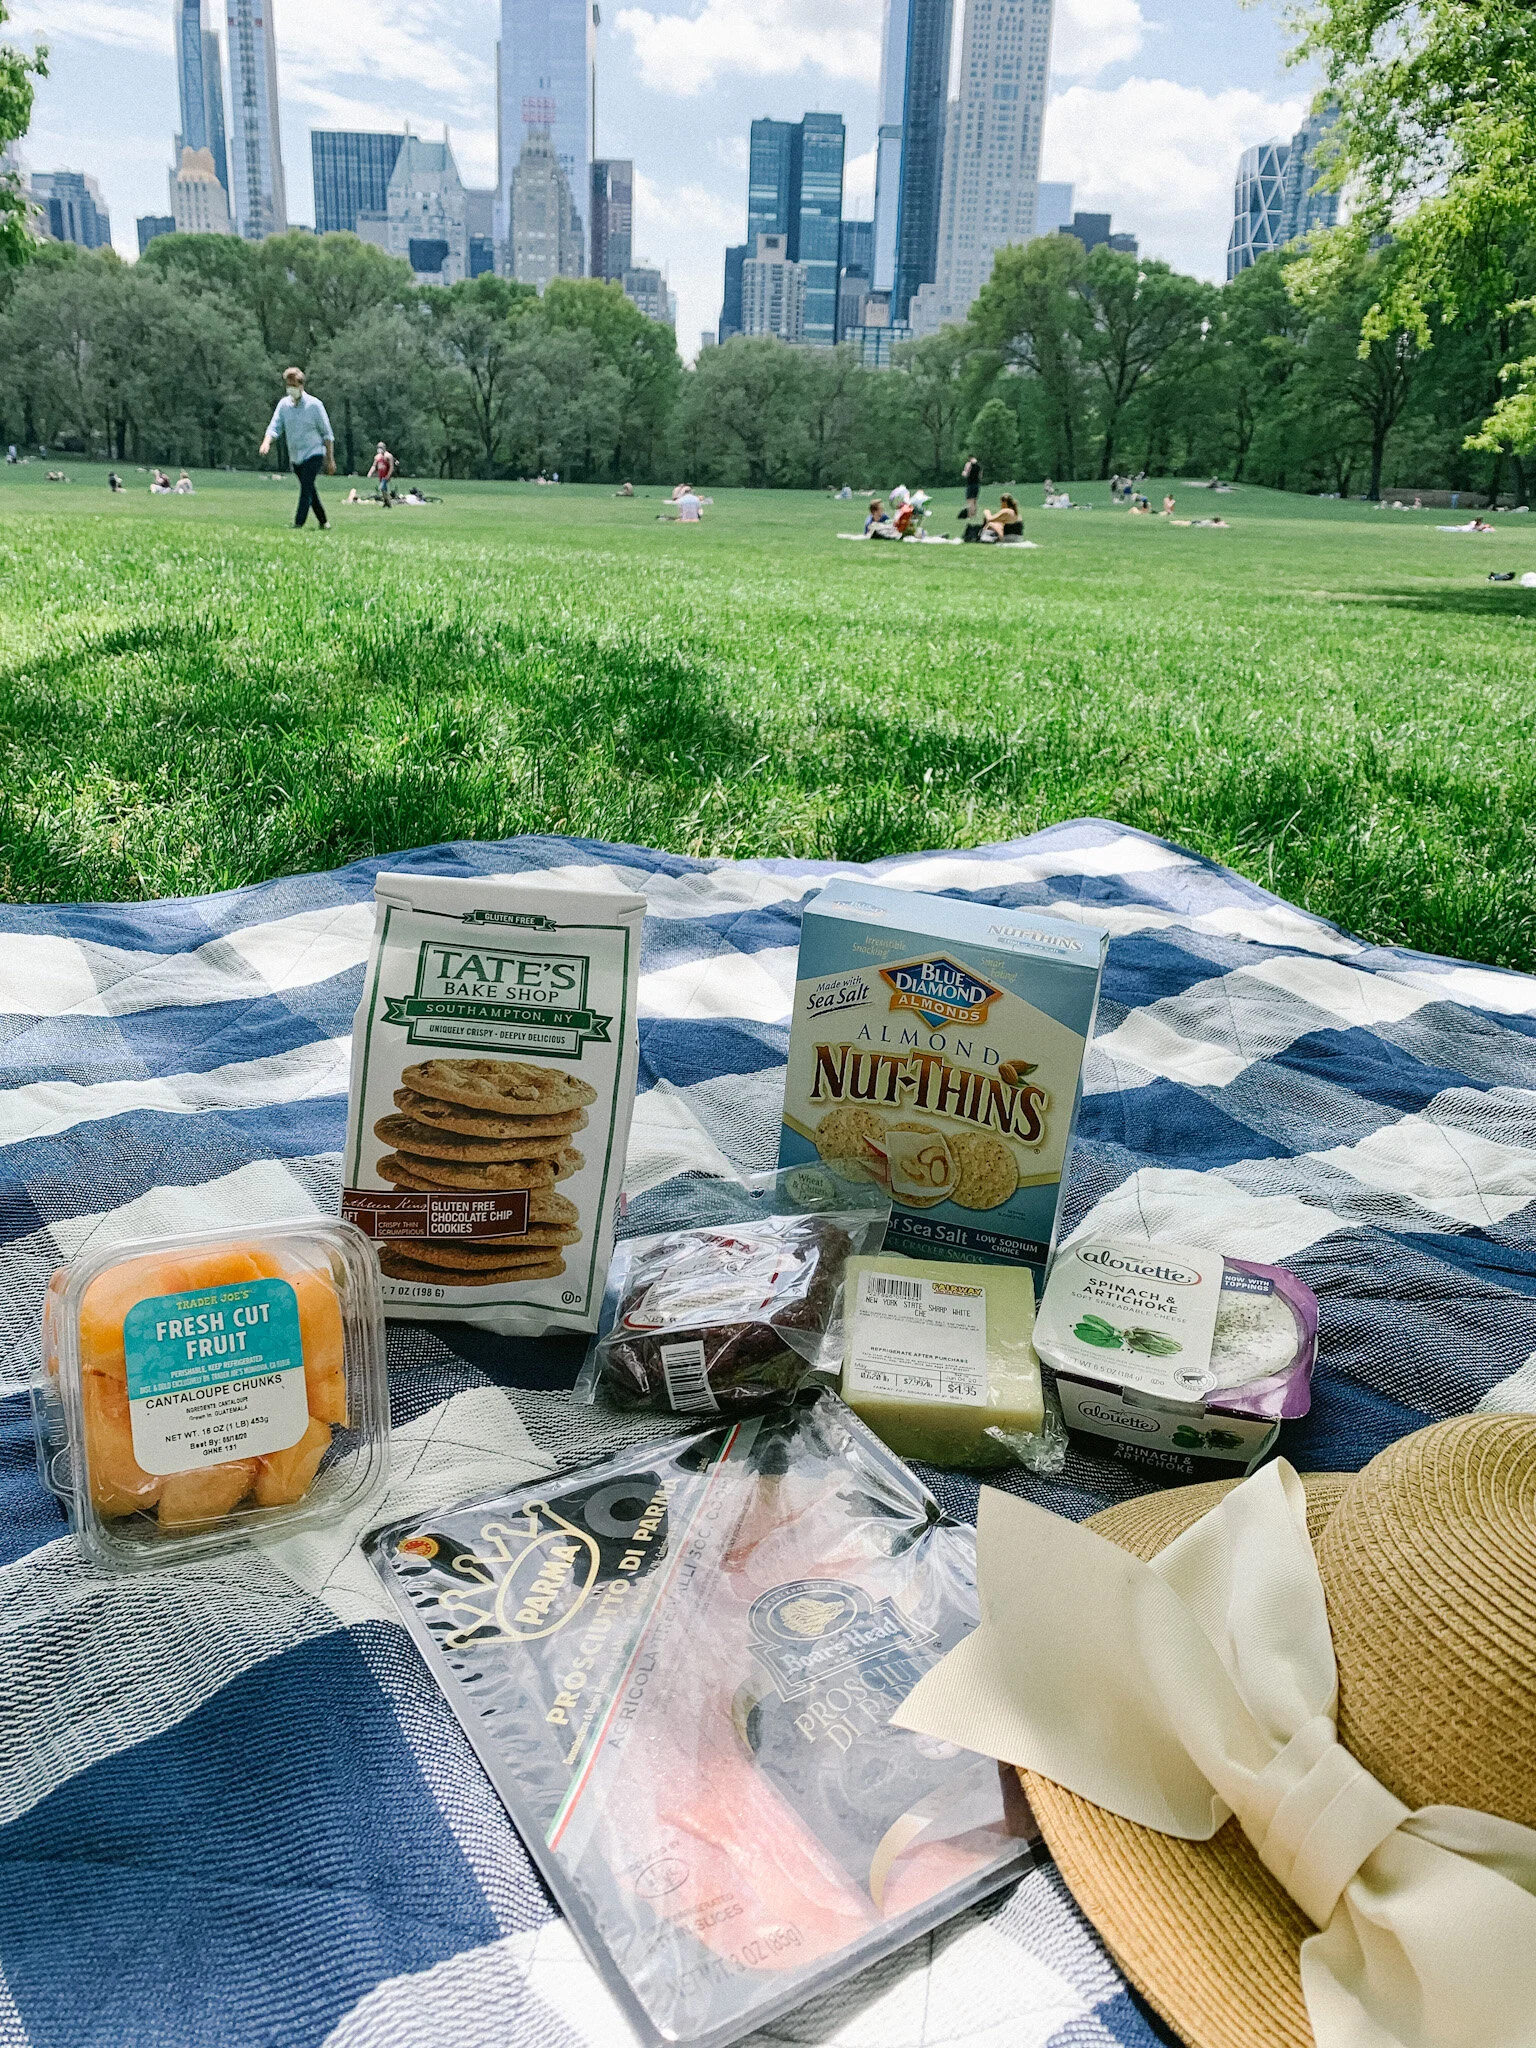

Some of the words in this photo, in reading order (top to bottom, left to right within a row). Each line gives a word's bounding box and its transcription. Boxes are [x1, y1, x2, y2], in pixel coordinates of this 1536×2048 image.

[483, 912, 514, 924] GLUTEN
[515, 915, 536, 925] FREE
[433, 949, 576, 990] TATE'S
[920, 962, 965, 987] BLUE
[444, 981, 498, 998] BAKE
[506, 986, 560, 1003] SHOP
[816, 978, 840, 993] Made
[840, 975, 862, 989] with
[895, 971, 987, 1004] DIAMOND
[806, 992, 834, 1011] Sea
[837, 984, 870, 1004] Salt
[898, 994, 981, 1022] ALMONDS
[425, 1003, 546, 1023] SOUTHAMPTON,
[553, 1013, 574, 1025] NY
[429, 1024, 465, 1036] UNIQUELY
[466, 1027, 494, 1038] CRISPY
[499, 1030, 527, 1041] DEEPLY
[527, 1033, 566, 1045] DELICIOUS
[856, 1023, 1001, 1066] ALMOND
[342, 1211, 359, 1222] AFT
[431, 1200, 472, 1212] GLUTEN
[473, 1200, 496, 1212] FREE
[431, 1211, 487, 1223] CHOCOLATE
[489, 1210, 513, 1221] CHIP
[431, 1222, 473, 1235] COOKIES
[902, 1218, 932, 1237] Sea
[934, 1226, 968, 1245] Salt
[975, 1233, 997, 1243] LOW
[999, 1238, 1038, 1253] SODIUM
[991, 1244, 1020, 1256] CHOICE
[1083, 1250, 1186, 1283] alouette
[390, 1286, 395, 1295] 7
[398, 1287, 410, 1296] OZ
[412, 1287, 432, 1297] (198
[931, 1282, 982, 1296] FAIRWAY
[1088, 1278, 1163, 1303] SPINACH
[1166, 1296, 1176, 1305] &
[1224, 1280, 1270, 1292] TOPPINGS
[1225, 1274, 1246, 1284] NOW
[1247, 1277, 1270, 1287] WITH
[176, 1295, 218, 1311] TRADER
[220, 1290, 250, 1303] JOE'S
[865, 1296, 878, 1304] NEW
[882, 1298, 898, 1306] YORK
[903, 1301, 922, 1310] STATE
[952, 1308, 971, 1317] WHITE
[1071, 1291, 1093, 1302] SOFT
[1095, 1296, 1152, 1317] SPREADABLE
[1153, 1311, 1187, 1324] CHEESE
[1082, 1285, 1179, 1315] ARTICHOKE
[155, 1311, 225, 1342] FRESH
[232, 1303, 270, 1328] CUT
[186, 1331, 247, 1361] FRUIT
[145, 1384, 230, 1409] CANTALOUPE
[233, 1374, 282, 1393] CHUNKS
[165, 1433, 182, 1443] NET
[184, 1430, 200, 1440] WT.
[213, 1424, 225, 1433] OZ
[235, 1419, 249, 1429] LB)
[250, 1416, 269, 1426] 453g
[1083, 1405, 1151, 1430] alouette
[190, 1440, 207, 1450] Best
[1117, 1442, 1181, 1464] SPINACH
[1184, 1456, 1193, 1465] &
[1113, 1450, 1194, 1474] ARTICHOKE
[515, 1544, 582, 1625] PARMA
[545, 1579, 631, 1726] PROSCIUTTO
[618, 1550, 646, 1571] DI
[632, 1478, 680, 1542] PARMA
[842, 1616, 902, 1648] Head
[608, 1652, 660, 1749] AGRICOLA
[793, 1654, 940, 1743] PROSCIUT
[825, 1712, 863, 1754] DI
[742, 1940, 769, 1965] OZ
